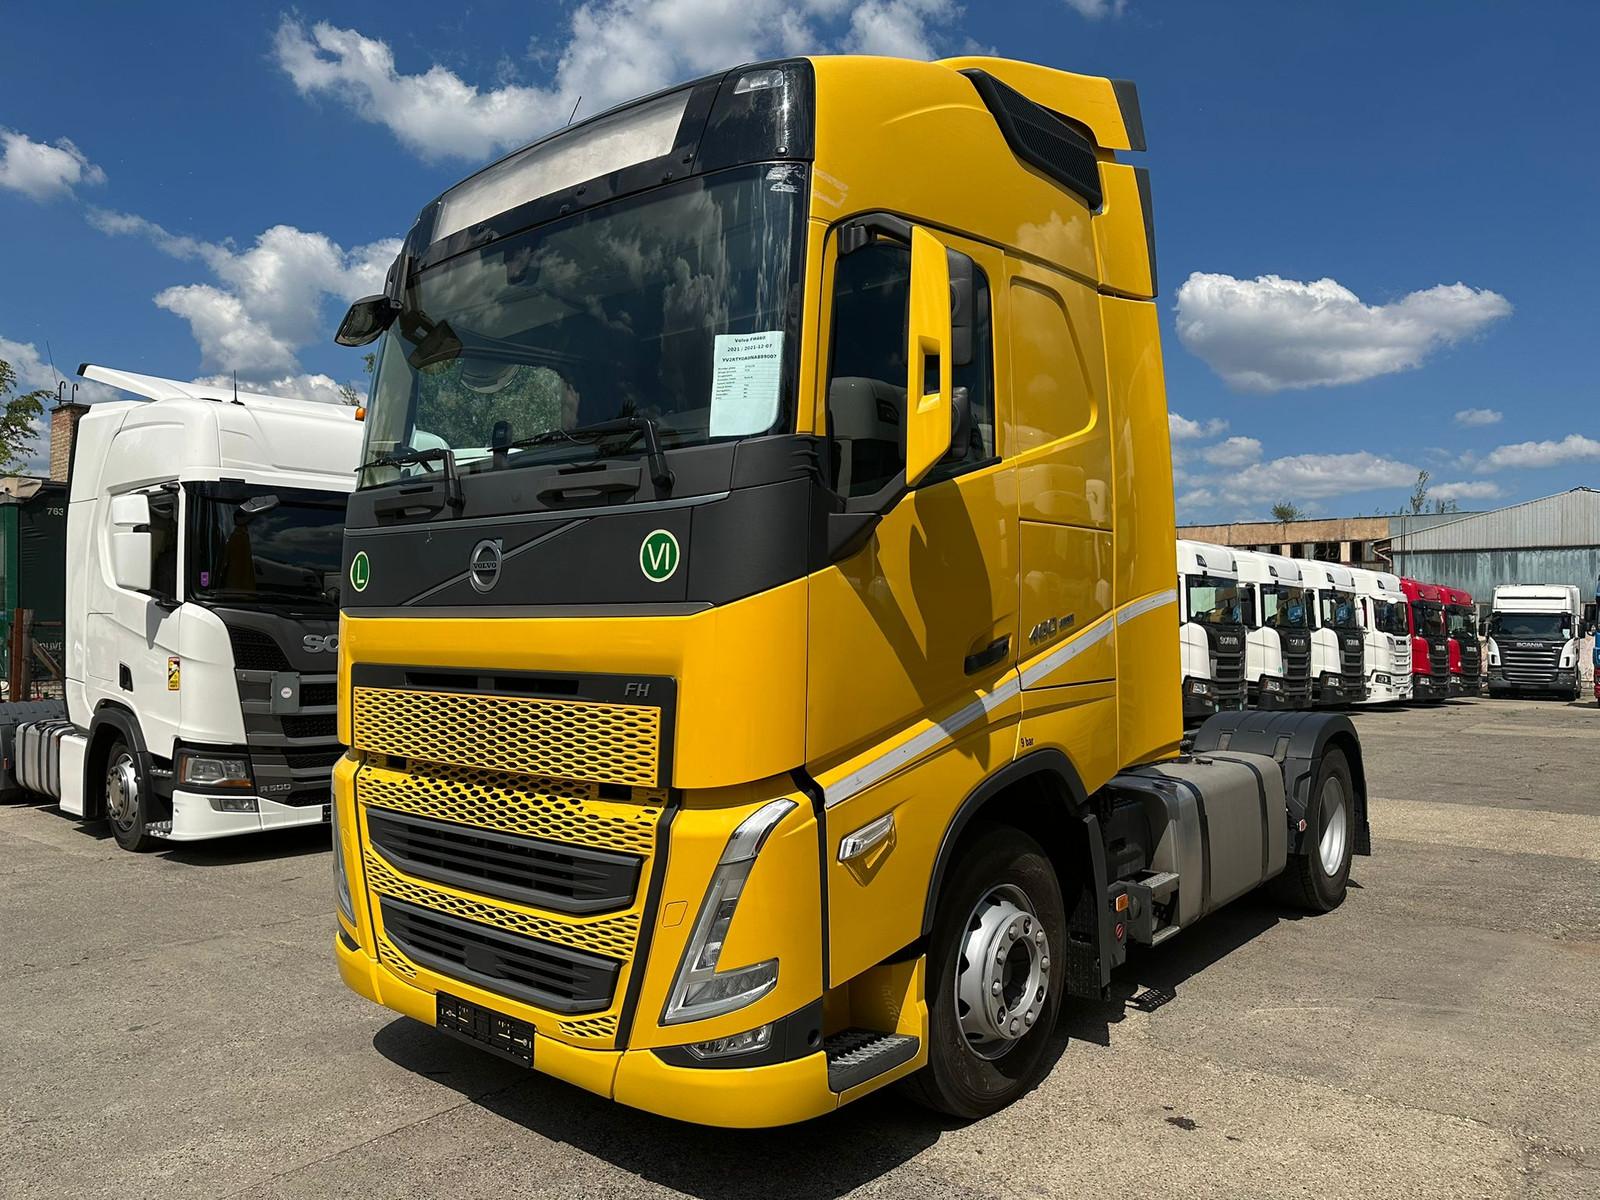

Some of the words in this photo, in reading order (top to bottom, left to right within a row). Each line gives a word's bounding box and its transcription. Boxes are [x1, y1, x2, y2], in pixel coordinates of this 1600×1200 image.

[647, 542, 670, 571] VI
[356, 559, 365, 584] L
[624, 682, 650, 697] FH
[270, 783, 291, 791] 500
